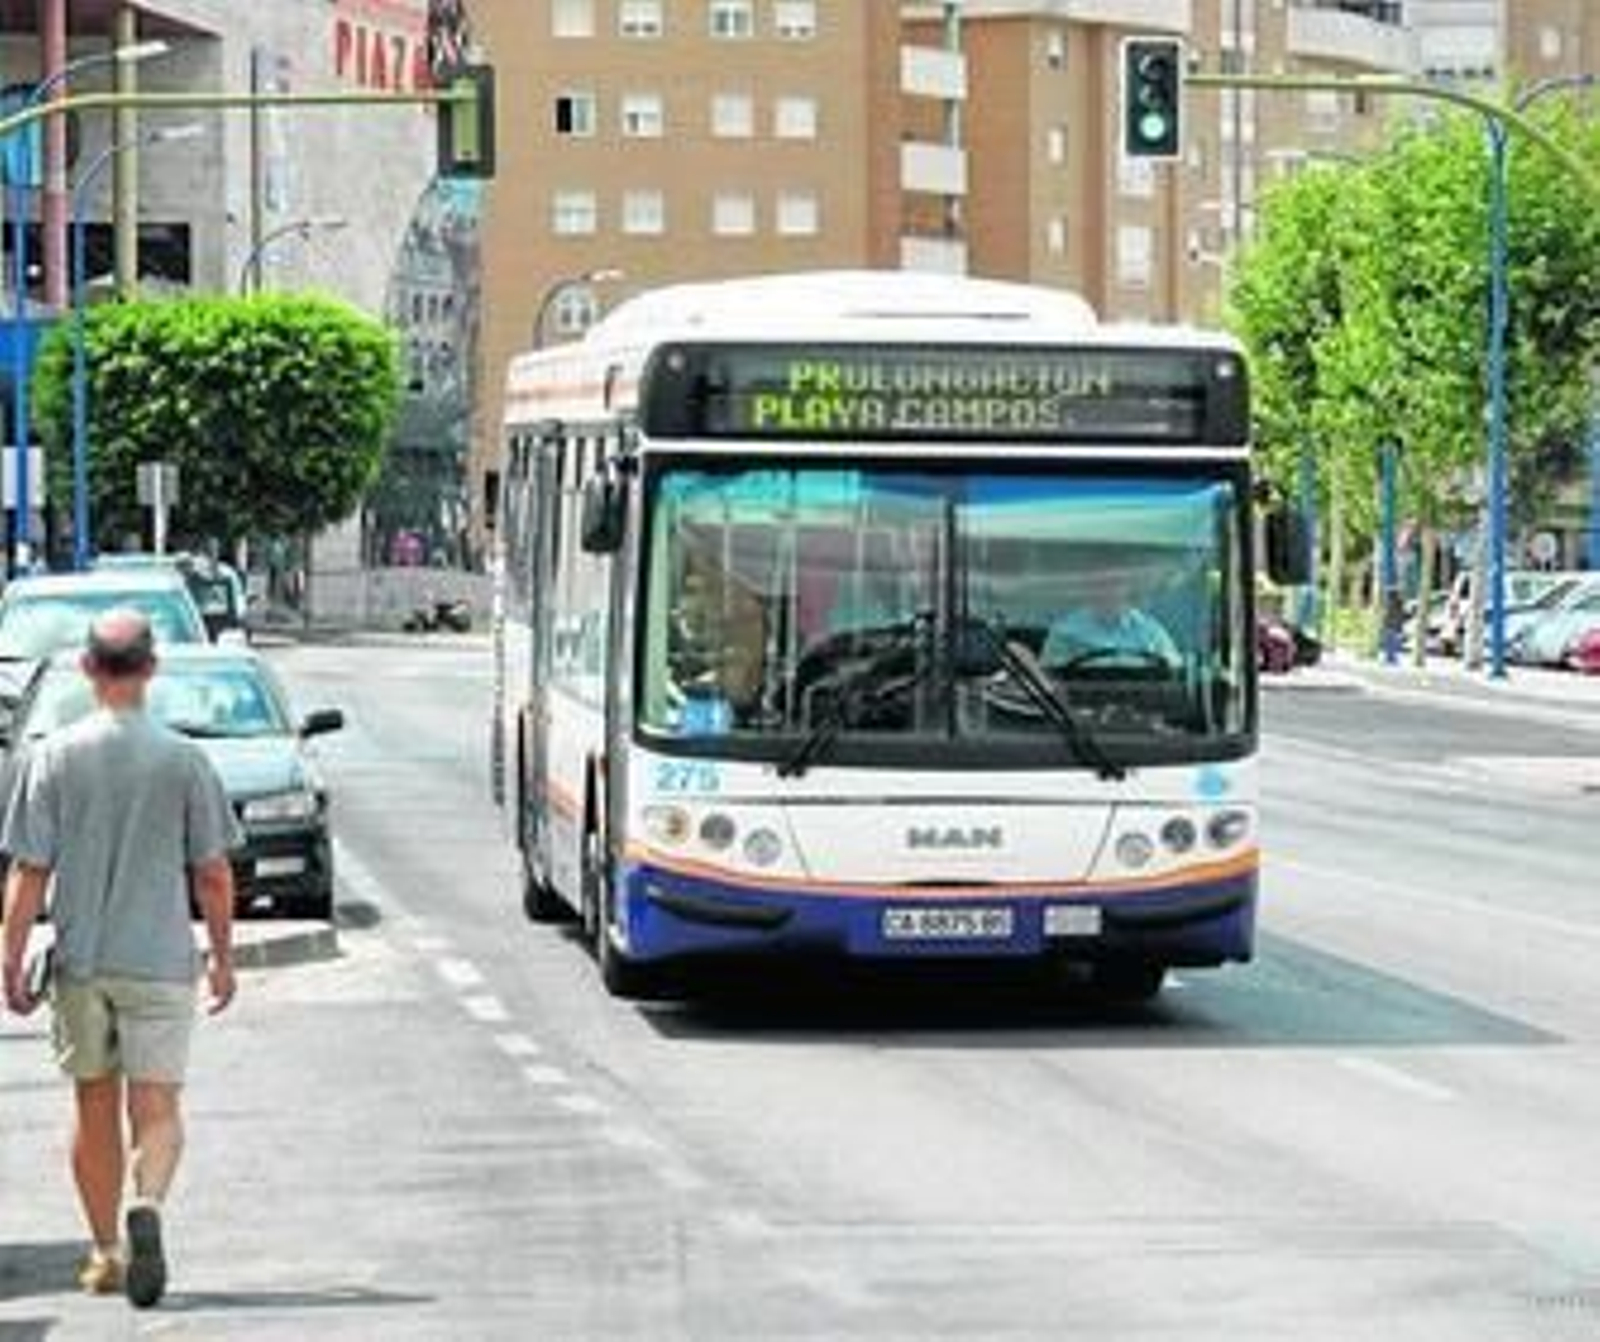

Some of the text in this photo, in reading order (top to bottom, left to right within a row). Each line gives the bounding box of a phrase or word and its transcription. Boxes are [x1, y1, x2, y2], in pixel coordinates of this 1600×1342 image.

[754, 395, 883, 428] PLAYA
[656, 761, 721, 791] 275
[907, 825, 1003, 849] MAN
